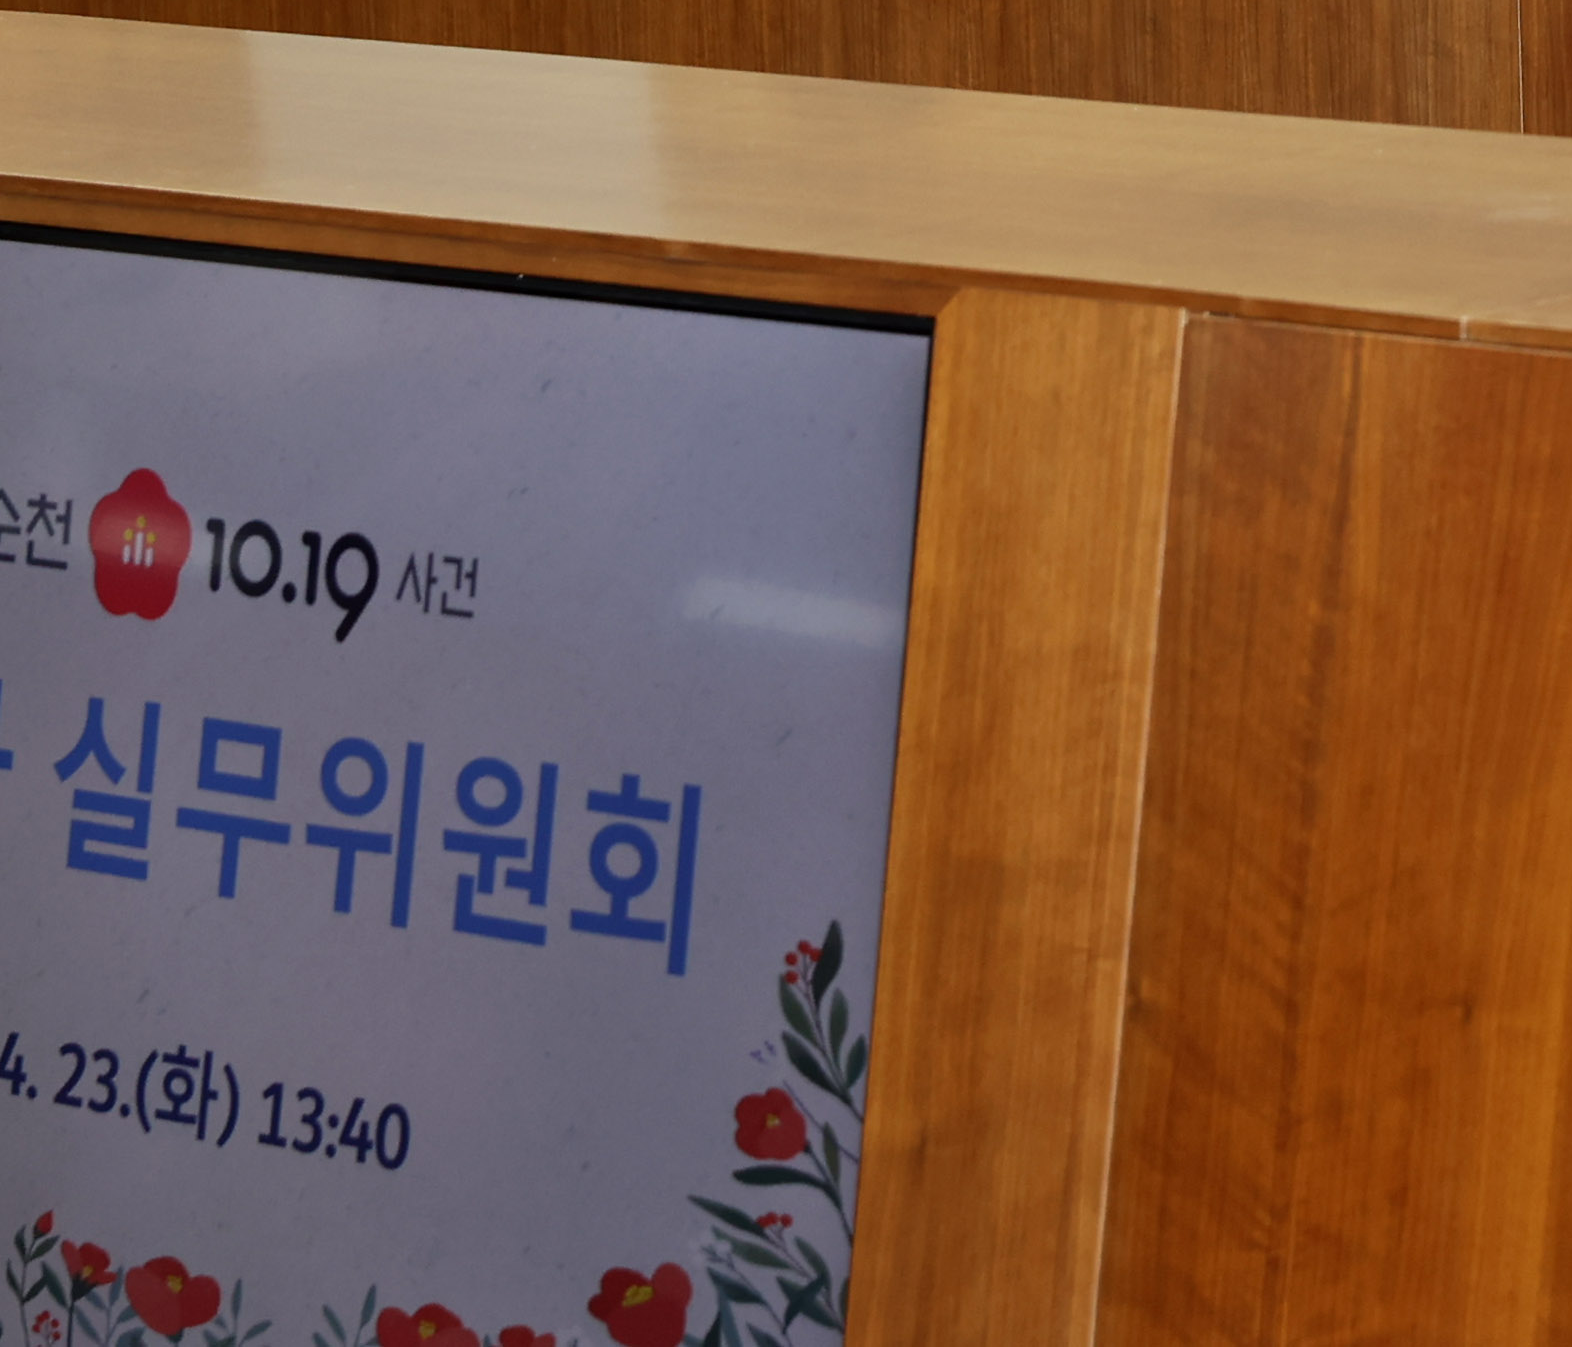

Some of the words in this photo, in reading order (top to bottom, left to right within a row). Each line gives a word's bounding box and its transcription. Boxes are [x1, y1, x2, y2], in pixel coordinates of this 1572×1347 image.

[206, 517, 381, 643] 10.19
[395, 552, 480, 619] 사건
[53, 696, 703, 977] 실무위원회
[53, 1041, 240, 1149] 23.(화)
[257, 1081, 411, 1172] 13:40
